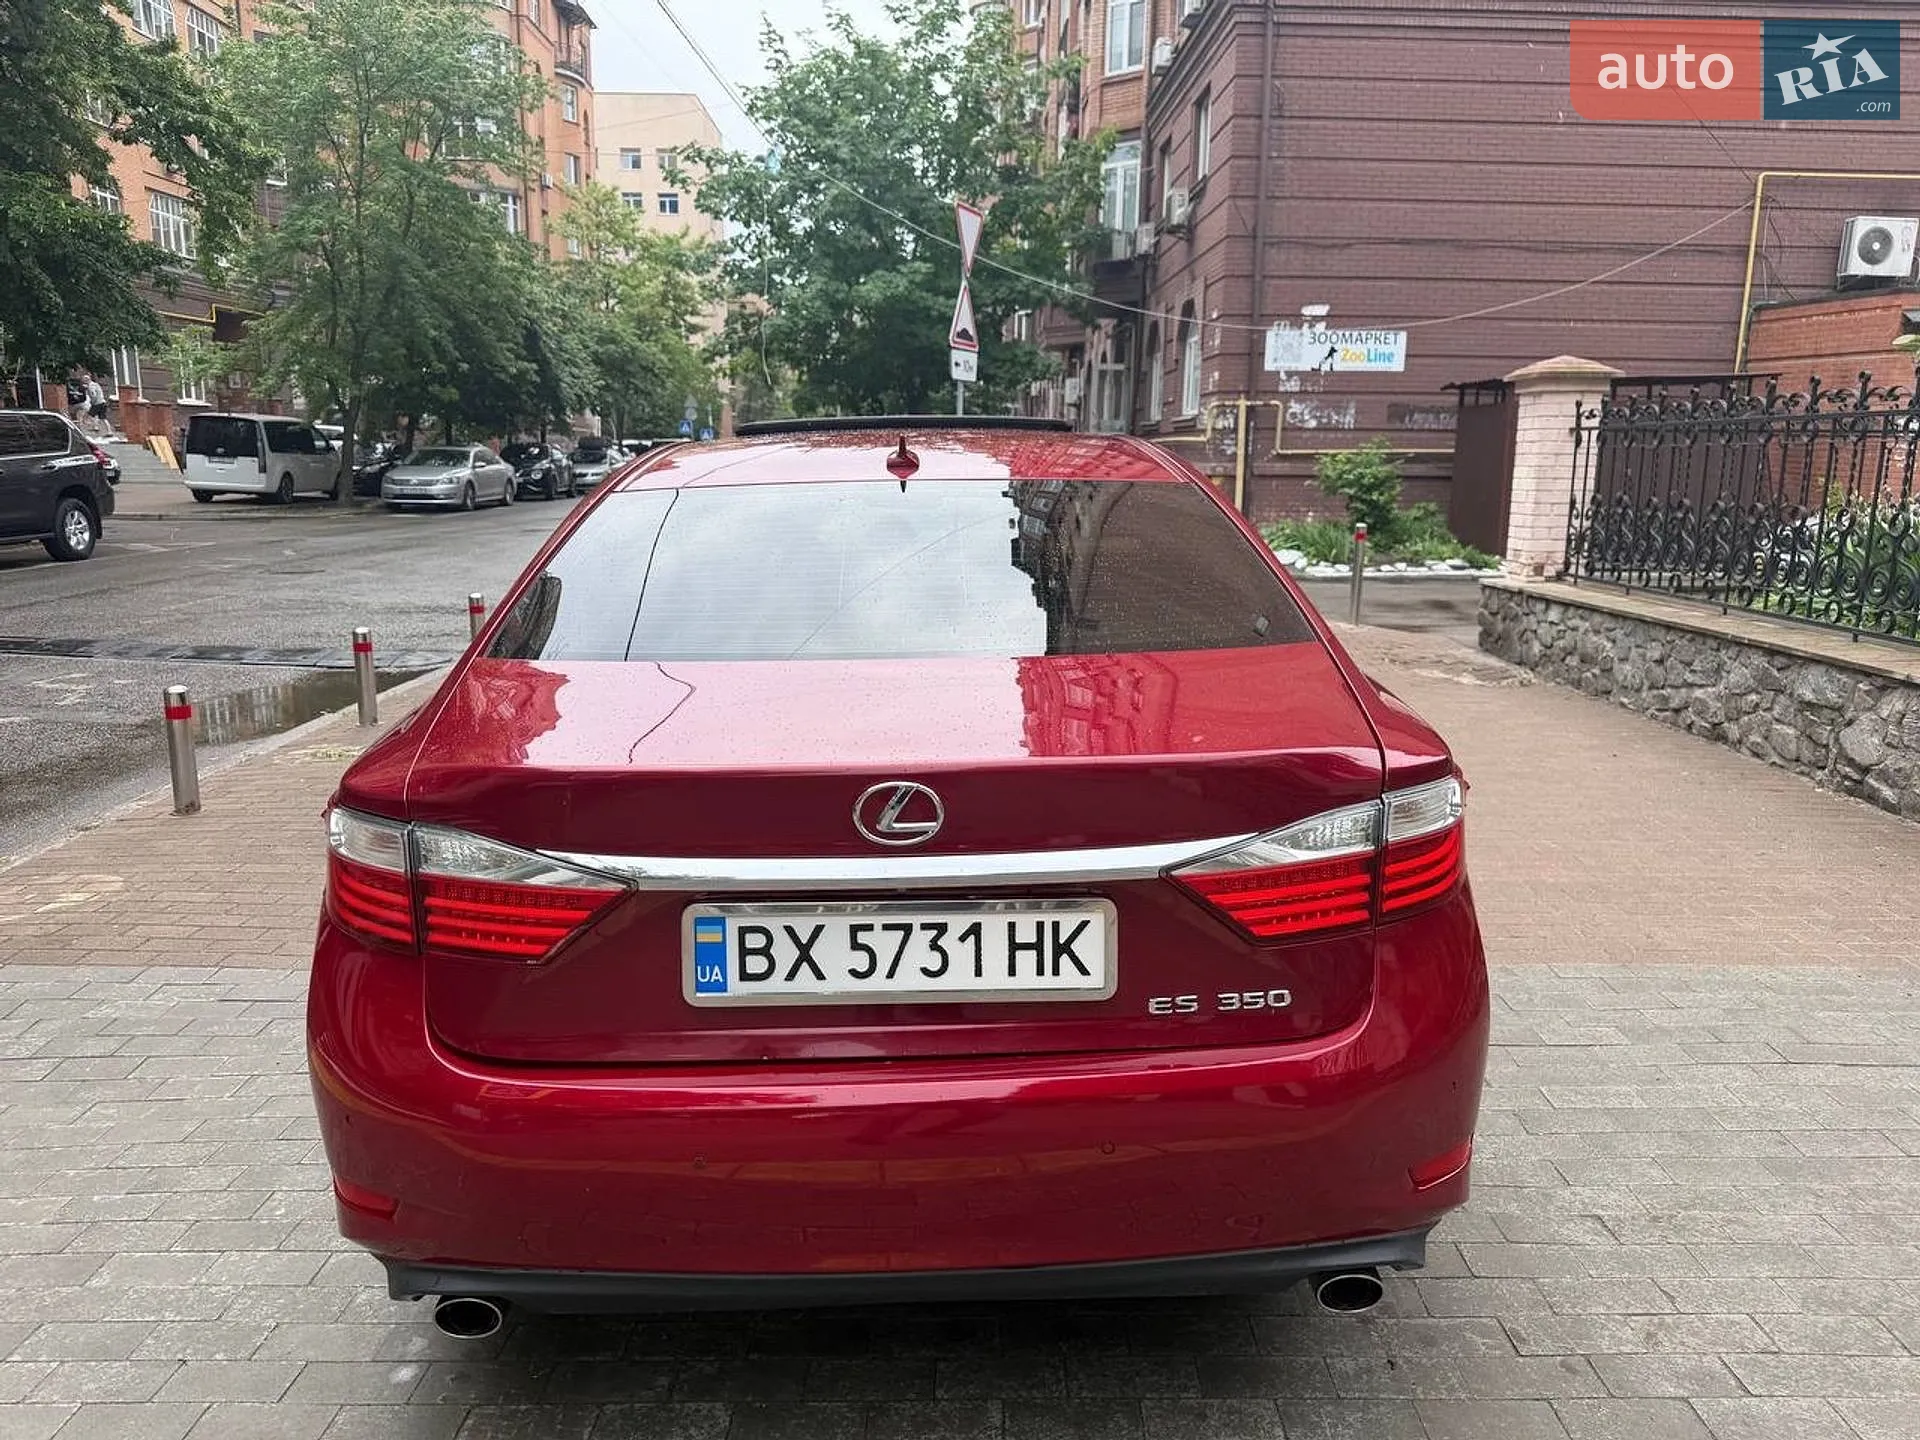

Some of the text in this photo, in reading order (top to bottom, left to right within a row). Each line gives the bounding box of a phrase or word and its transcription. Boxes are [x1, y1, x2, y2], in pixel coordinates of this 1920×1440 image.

[1308, 331, 1400, 345] ЗООМАРКЕТ
[737, 919, 1091, 983] BX 5731 HK
[697, 966, 723, 983] UA
[1148, 989, 1292, 1014] ES 350
